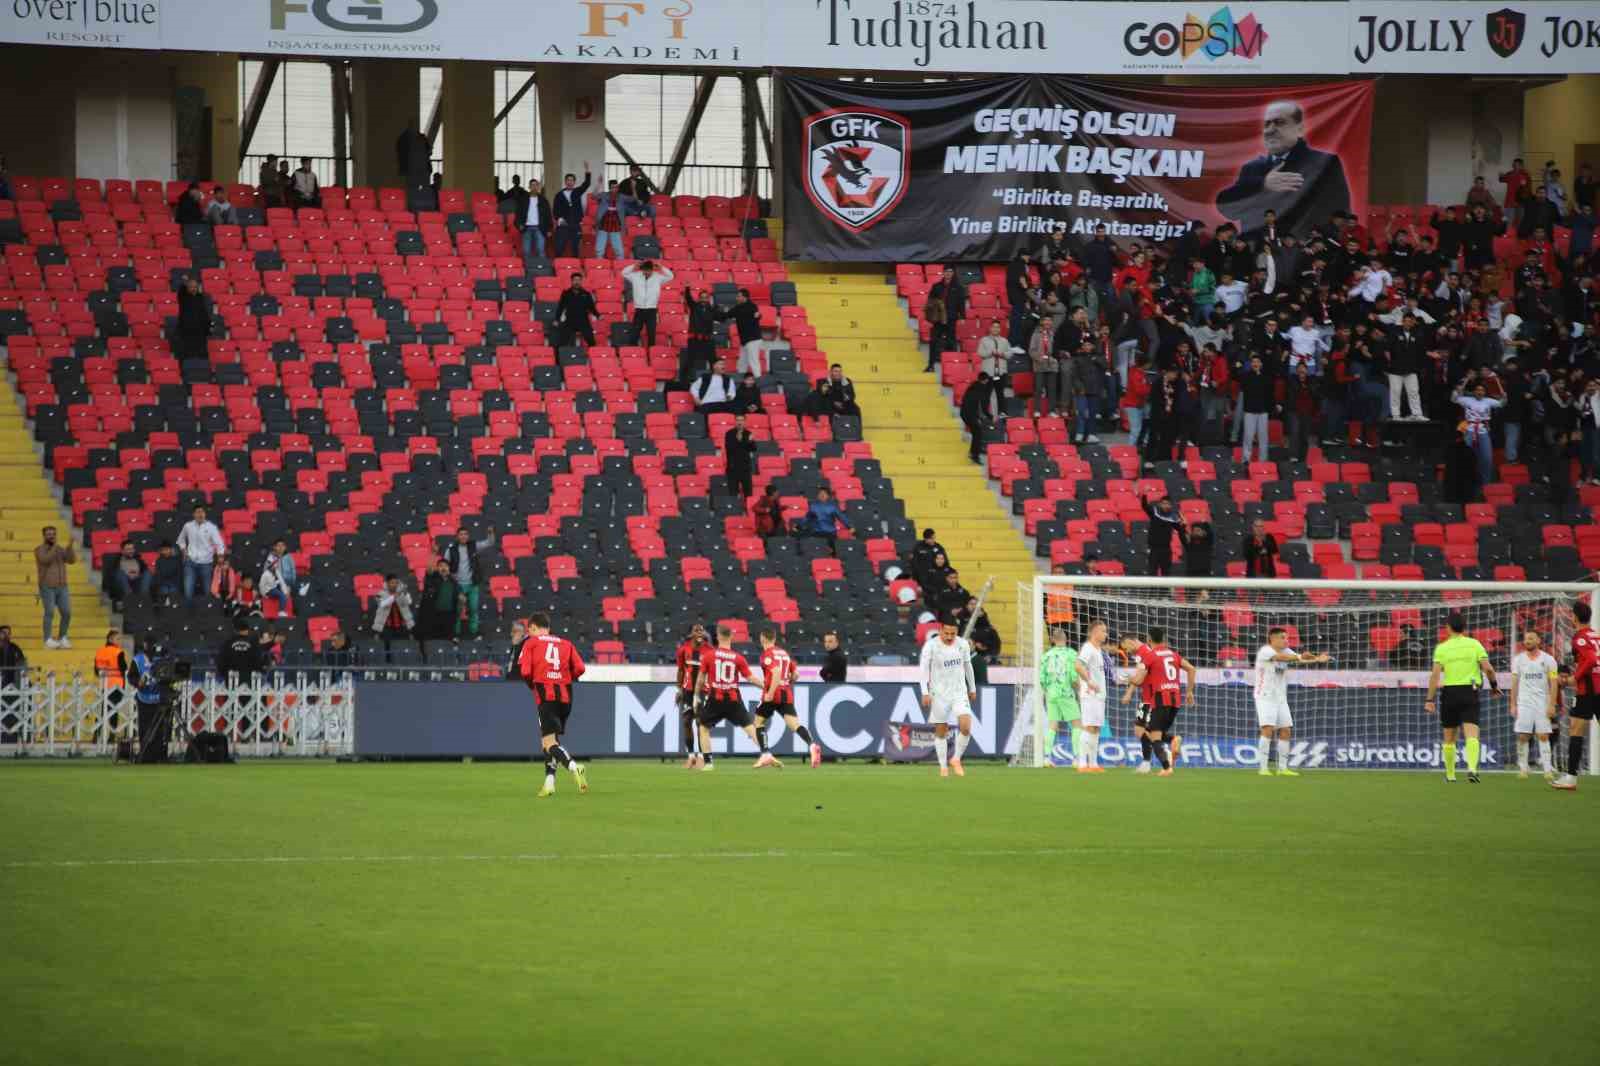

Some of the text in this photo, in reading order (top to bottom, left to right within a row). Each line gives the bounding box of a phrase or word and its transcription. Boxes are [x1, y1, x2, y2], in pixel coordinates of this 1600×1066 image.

[905, 0, 958, 17] 1874
[46, 32, 126, 43] RESORT
[815, 0, 1048, 66] Tudyahan
[1354, 15, 1473, 64] JOLLY
[543, 44, 743, 61] AKADEMİ
[831, 118, 882, 138] GFK
[973, 104, 1177, 139] GEÇMİŞ OLSUN
[944, 139, 1204, 183] MEMİK BAŞKAN
[950, 217, 992, 234] Yine
[545, 643, 560, 670] 4
[1163, 656, 1177, 681] 6
[714, 659, 737, 684] 10
[1336, 742, 1497, 767] süratlojk
